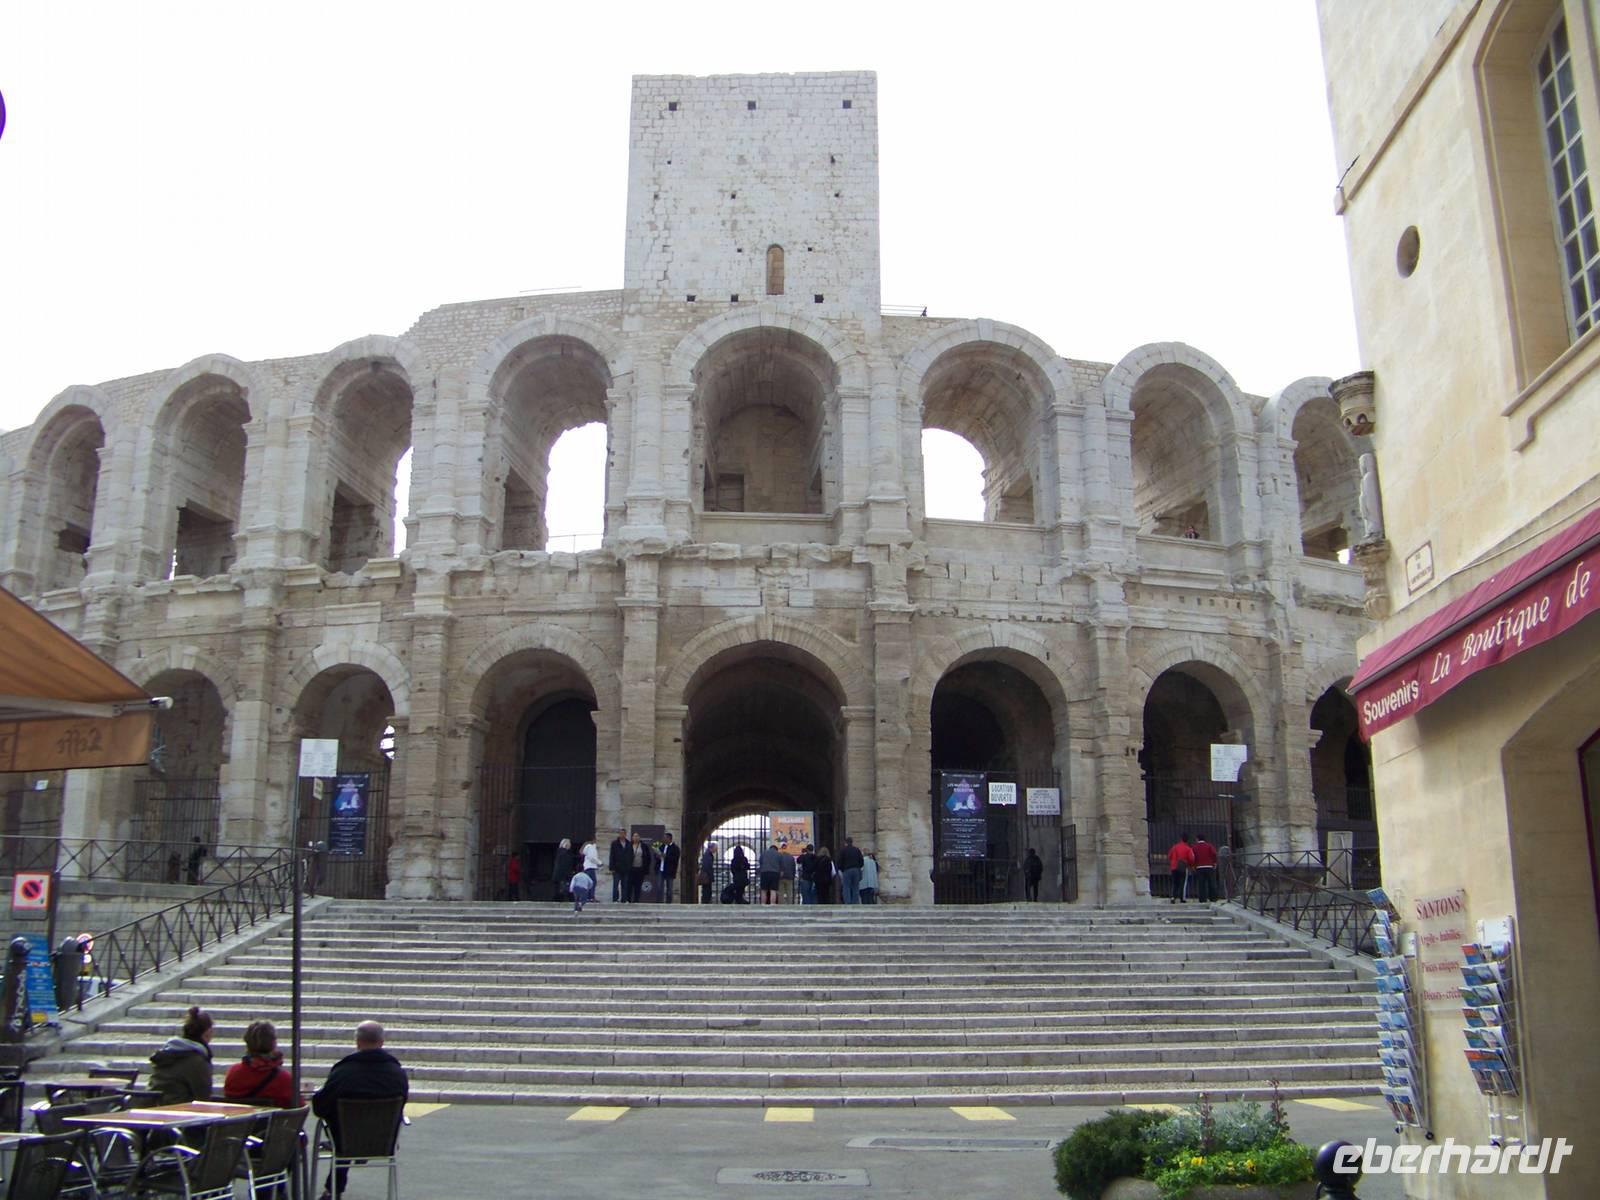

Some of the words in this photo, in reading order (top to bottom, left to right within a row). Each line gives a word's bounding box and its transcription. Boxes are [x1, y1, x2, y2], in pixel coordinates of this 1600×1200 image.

[1364, 680, 1419, 725] Souvenirs
[1430, 652, 1451, 685] La
[1461, 595, 1550, 666] Boutique
[1566, 561, 1591, 608] de
[1416, 896, 1461, 920] SANTONS
